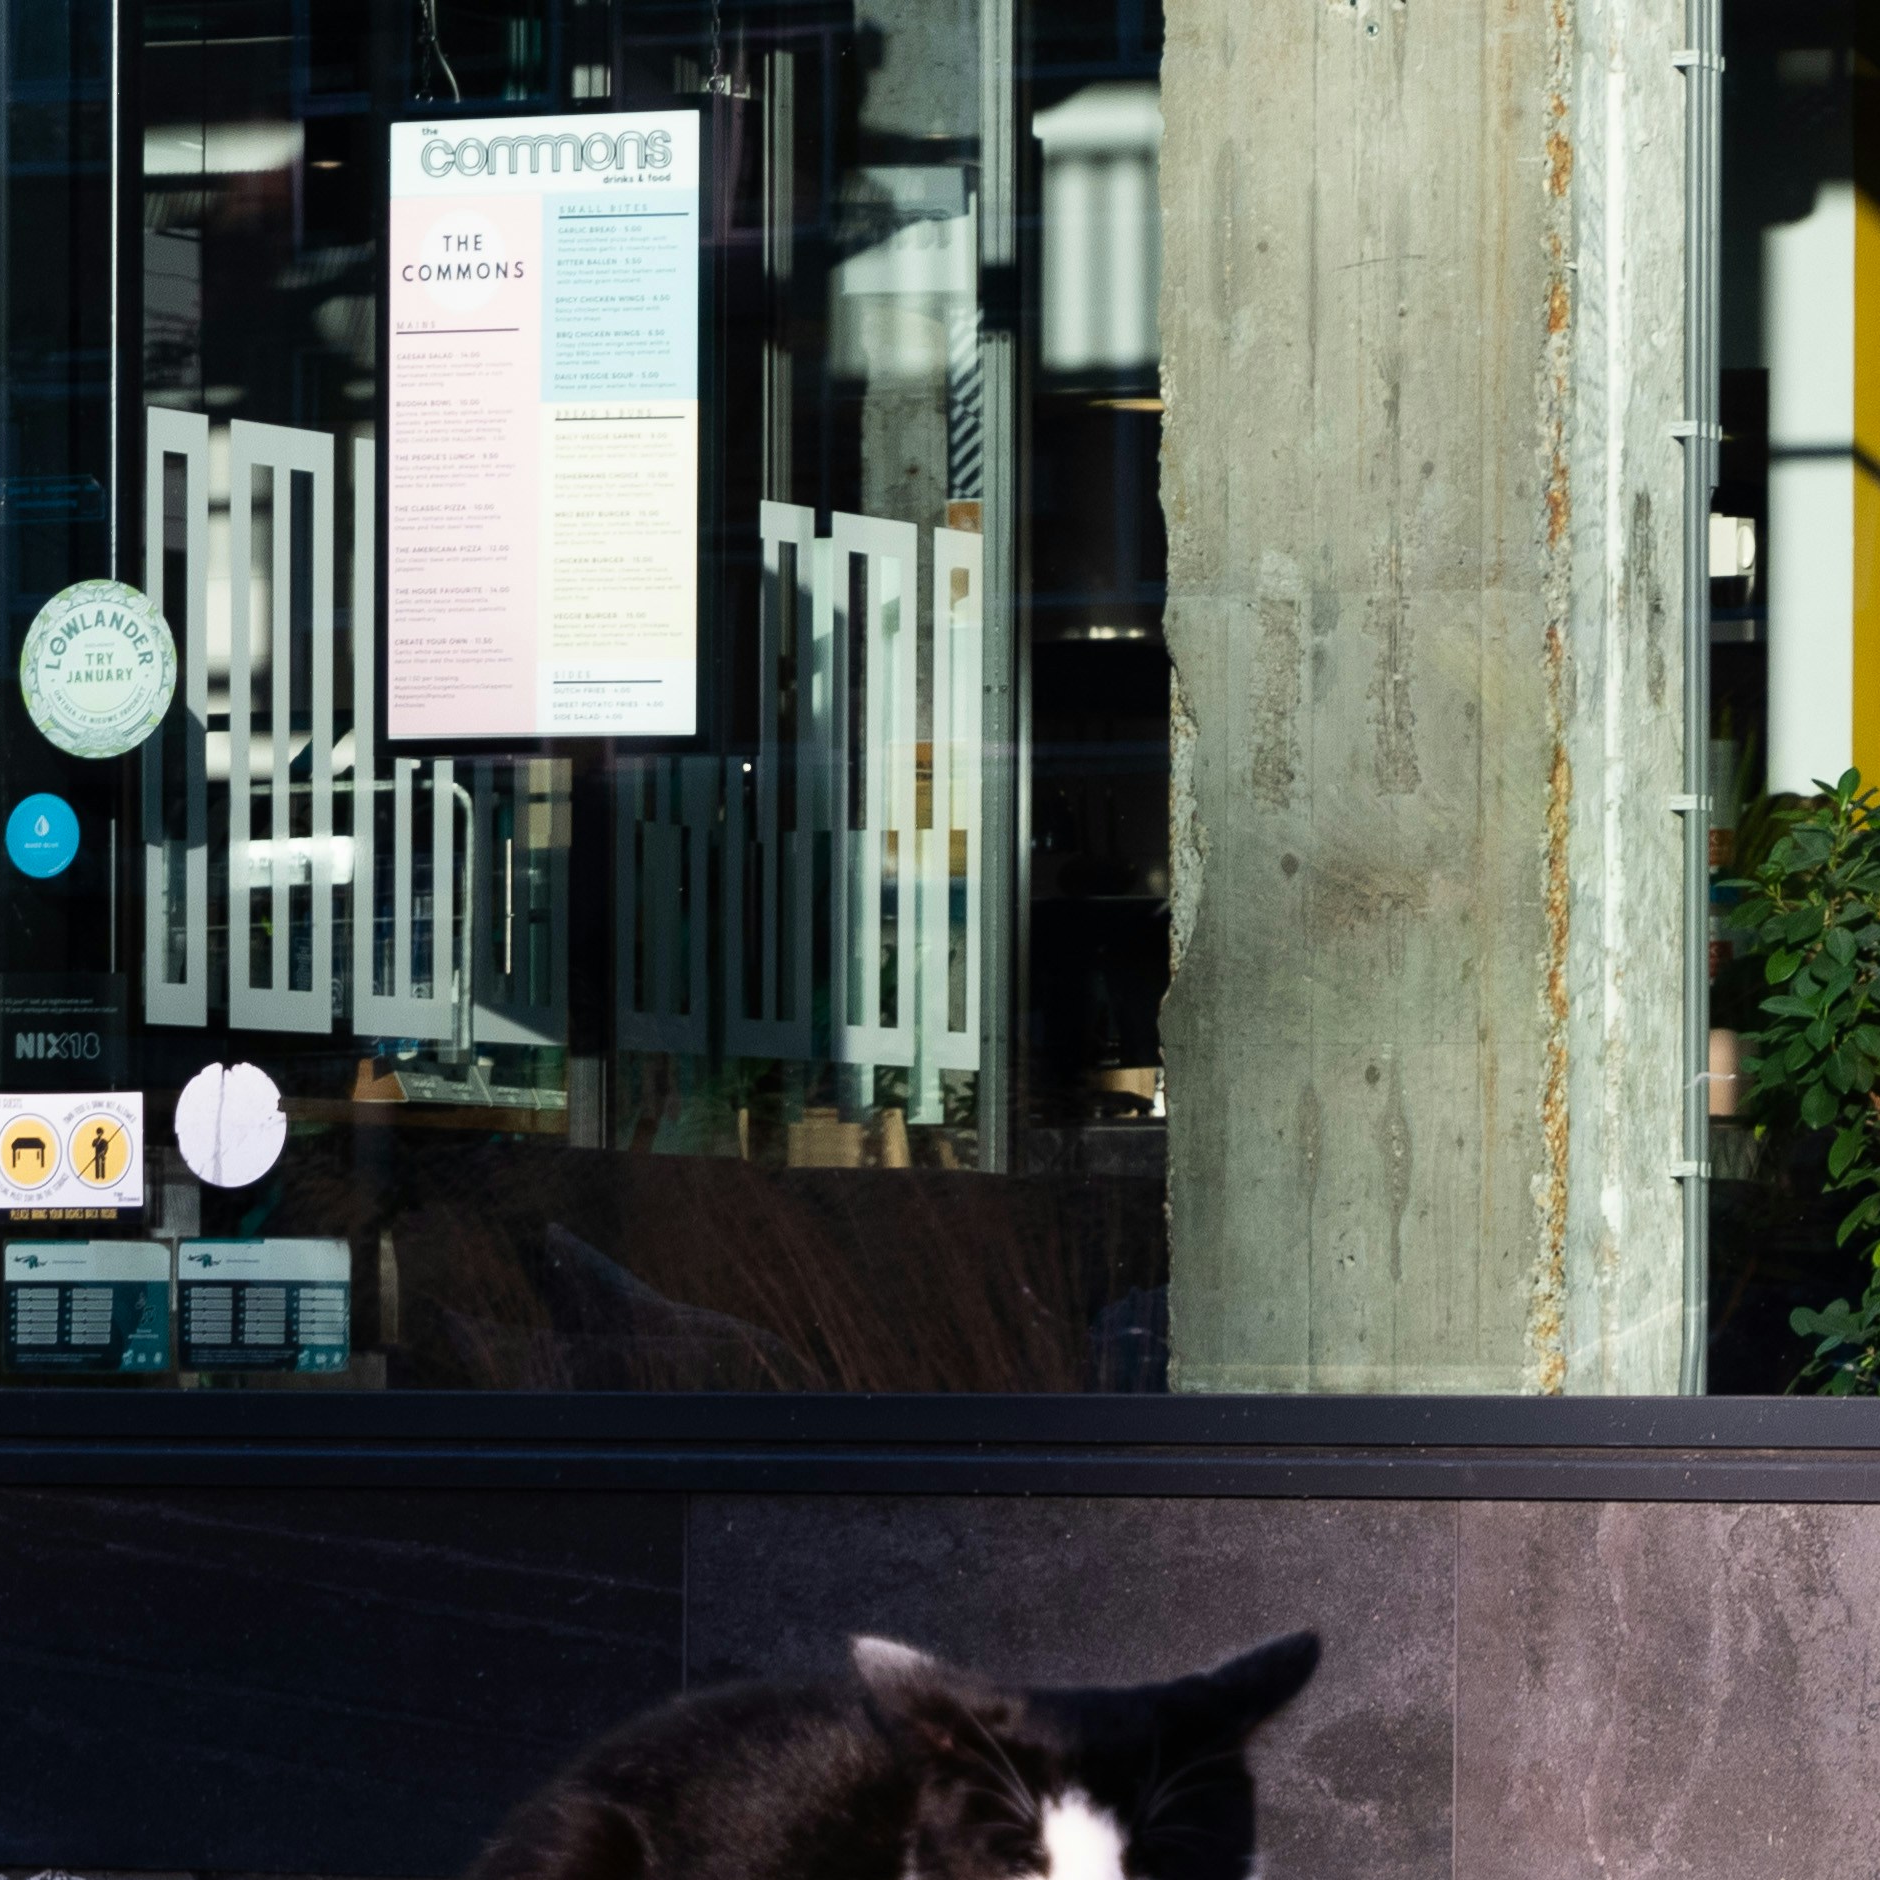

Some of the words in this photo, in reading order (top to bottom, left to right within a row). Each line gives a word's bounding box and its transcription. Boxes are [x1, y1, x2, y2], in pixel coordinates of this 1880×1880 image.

[421, 126, 439, 137] the
[421, 129, 673, 178] commons
[603, 174, 634, 185] drinks
[637, 174, 644, 184] &
[647, 173, 671, 184] food
[559, 204, 602, 214] SMALL
[610, 203, 648, 212] BITES
[558, 225, 587, 234] GARLIC
[588, 225, 617, 233] BREAD
[442, 234, 483, 253] THE
[557, 258, 584, 266] BITTER
[586, 258, 618, 266] BALLEN
[402, 260, 526, 282] COMMONS
[555, 296, 578, 304] SPICY
[579, 295, 616, 304] CHICKEN
[618, 295, 646, 303] WINGS
[396, 320, 436, 330] MAINS
[556, 331, 573, 339] BBQ
[574, 330, 612, 338] CHICKEN
[613, 329, 640, 338] WINGS
[428, 352, 454, 360] SALAD
[554, 373, 578, 381] DAILY
[580, 372, 609, 380] VEGGIE
[611, 372, 634, 380] SOUP
[430, 399, 452, 407] BOWL
[556, 409, 597, 418] BREAD
[619, 408, 652, 417] BUNS
[449, 453, 475, 461] LUNCH
[598, 510, 630, 518] BURGER
[395, 546, 409, 554] THE
[411, 587, 437, 595] HOUSE
[394, 638, 423, 646] CREATE
[85, 653, 114, 667] TRY
[66, 667, 133, 684] JANUARY
[554, 670, 591, 680] SIDES
[553, 687, 581, 695] DUTCH
[615, 700, 639, 708] FRIES
[15, 1032, 101, 1060] NIX18
